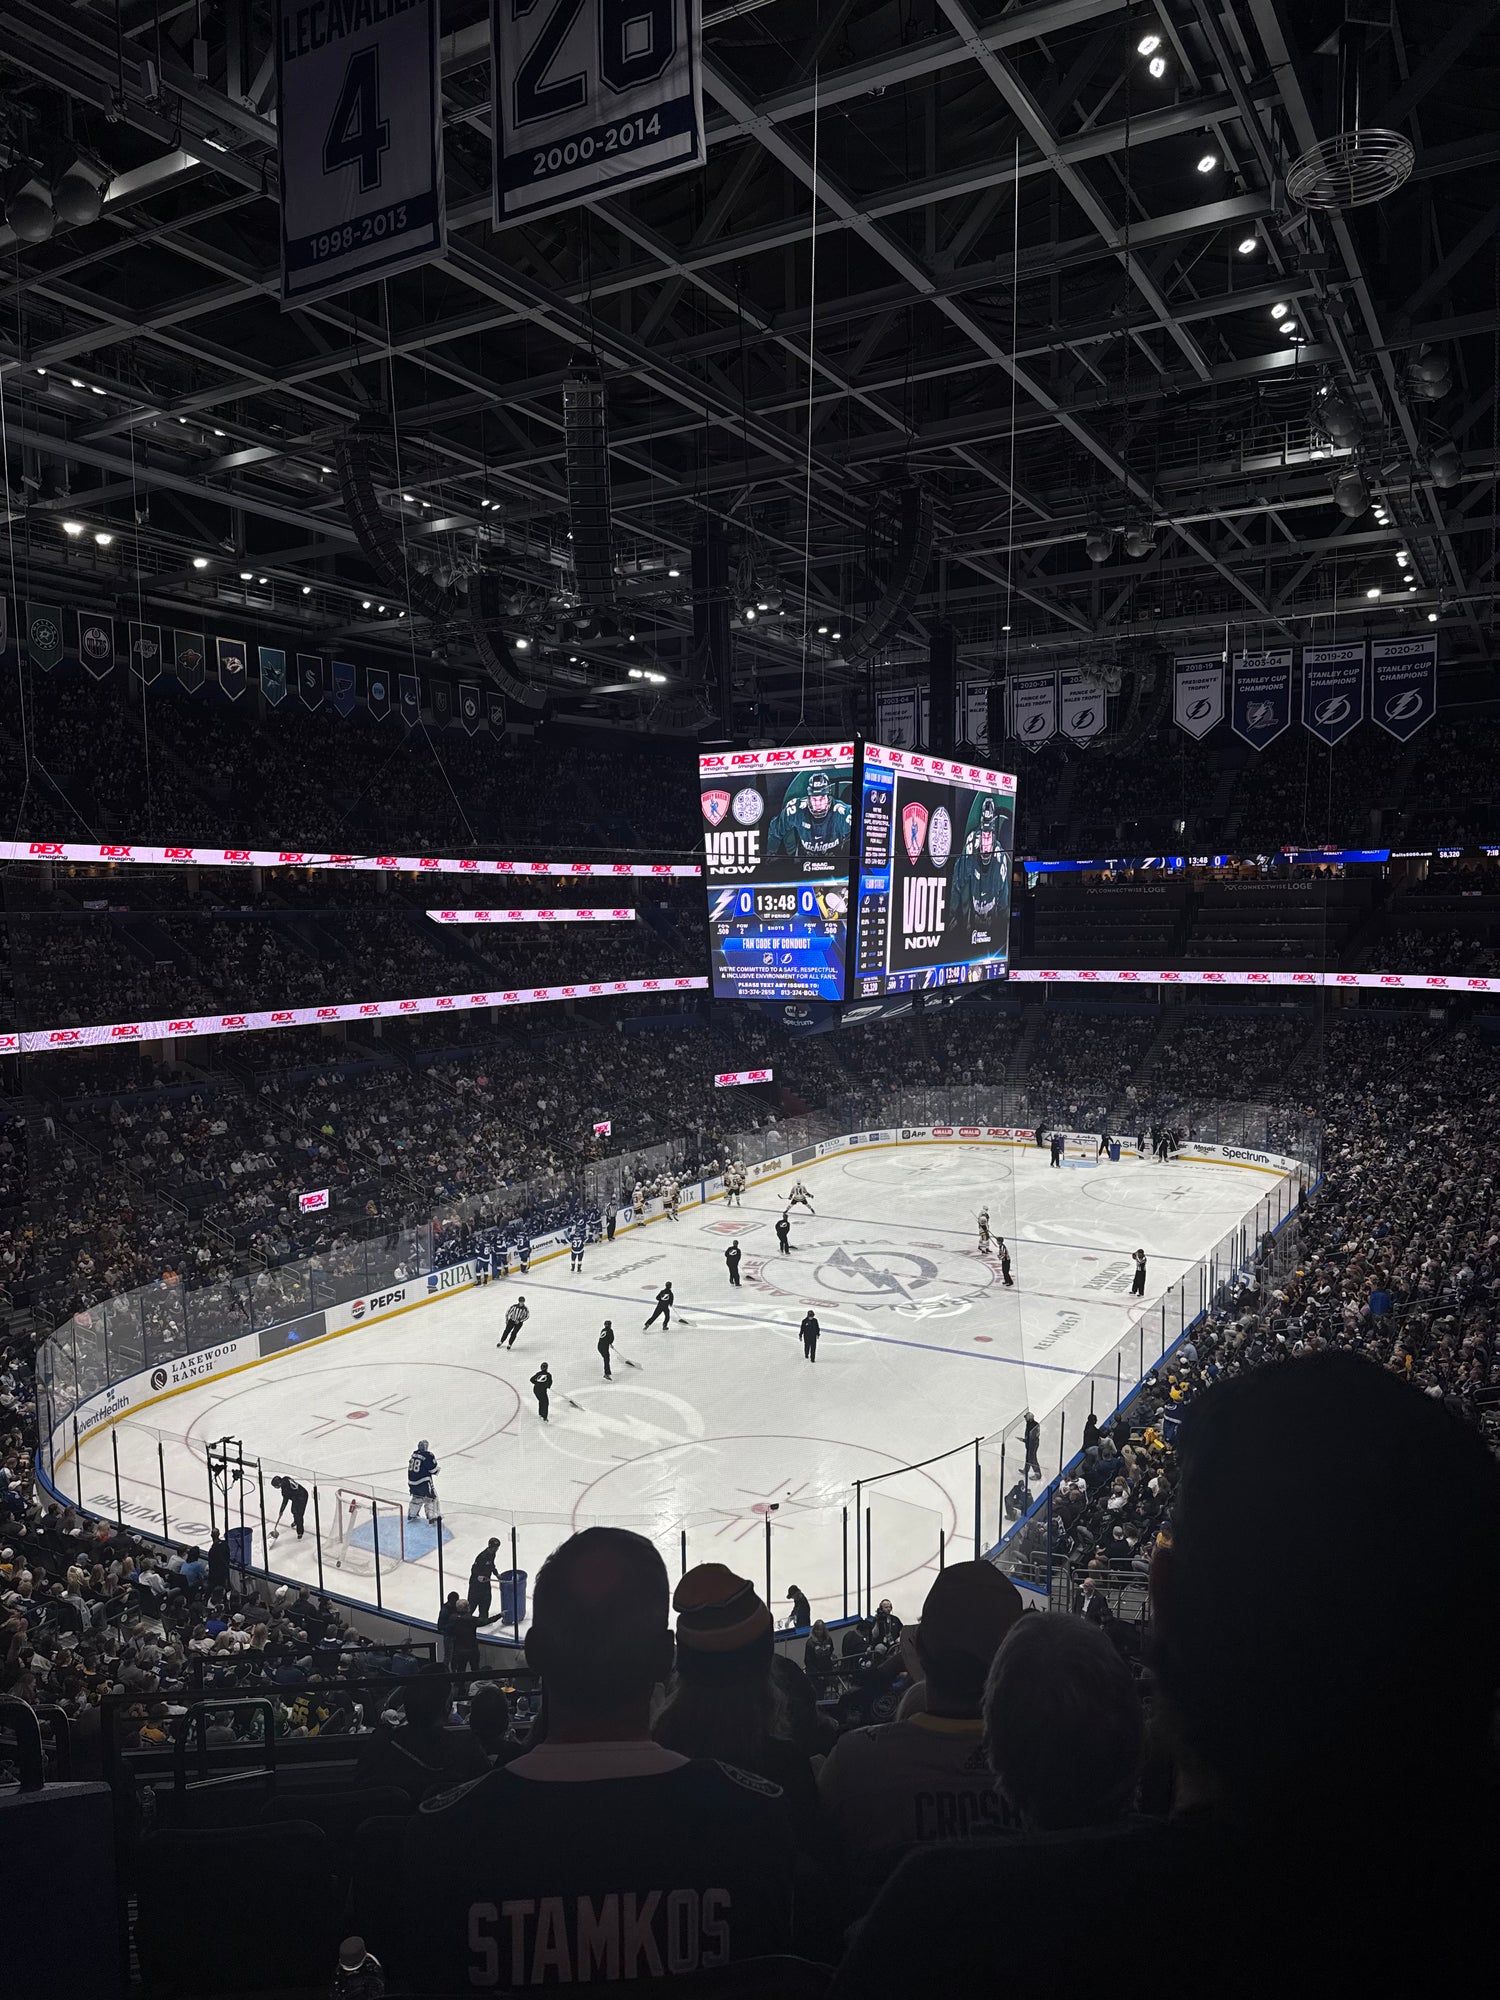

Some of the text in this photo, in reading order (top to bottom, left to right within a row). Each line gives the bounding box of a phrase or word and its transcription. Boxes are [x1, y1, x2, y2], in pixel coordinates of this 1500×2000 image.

[322, 44, 390, 194] 4
[533, 113, 661, 176] 2000-2014
[310, 205, 408, 260] 1998-2013
[1314, 651, 1353, 661] 2019-20
[1384, 644, 1424, 656] 2020-21
[1242, 657, 1282, 668] 2003-04
[1377, 661, 1432, 674] STANLEY CUP
[1237, 674, 1287, 685] STANLEY CUP
[1308, 668, 1360, 679] STANLEY CUP
[1379, 670, 1428, 681] CHAMPIONS
[1020, 681, 1047, 689] 2020-21
[1239, 682, 1284, 693] CHAMPIONS
[1310, 676, 1357, 687] CHAMPIONS
[1187, 684, 1210, 692] TROPHY
[699, 747, 833, 767] DEX DEX DEX DEX
[866, 746, 963, 775] DEX DEX DEX DEX DEX
[705, 830, 760, 866] VOTE
[802, 838, 840, 854] Michigan
[29, 843, 591, 872] DEX DEX DEX DEX DEX DEX DEX DEX DEX DEX
[1176, 857, 1182, 867] 0
[1215, 856, 1221, 866] 0
[710, 865, 756, 875] NOW
[741, 891, 813, 912] 0 13:48 0
[902, 877, 947, 934] VOTE
[441, 911, 457, 919] DEX
[759, 924, 763, 933] 1
[790, 924, 793, 932] 1
[742, 938, 811, 949] FAN CODE OF CONDUCT
[904, 935, 941, 950] NOW
[945, 966, 960, 980] 13:48
[0, 1005, 379, 1047] EX DEX DEX DEX DEX DEX DEX DEX
[783, 1018, 814, 1027] Spectrum
[57, 1039, 84, 1047] imaging
[719, 1071, 766, 1083] DEX DEX
[987, 1129, 1010, 1137] DEX
[1014, 1130, 1036, 1138] DEX
[824, 1139, 840, 1148] TECO
[1193, 1144, 1216, 1152] Mosaic
[1222, 1147, 1266, 1164] Spectrum
[302, 1193, 325, 1206] DEX
[572, 1240, 582, 1248] 37
[593, 1254, 667, 1282] Spectrum
[440, 1263, 473, 1291] RIPA
[1082, 1261, 1130, 1291] RAYMOND
[370, 1289, 406, 1311] PEPSI
[352, 1306, 366, 1314] PEPSI
[1033, 1314, 1082, 1351] RELIAQUEST
[172, 1343, 237, 1373] LAKEWOOD
[173, 1364, 213, 1384] RANCH
[468, 1888, 732, 1987] STAMKOS
